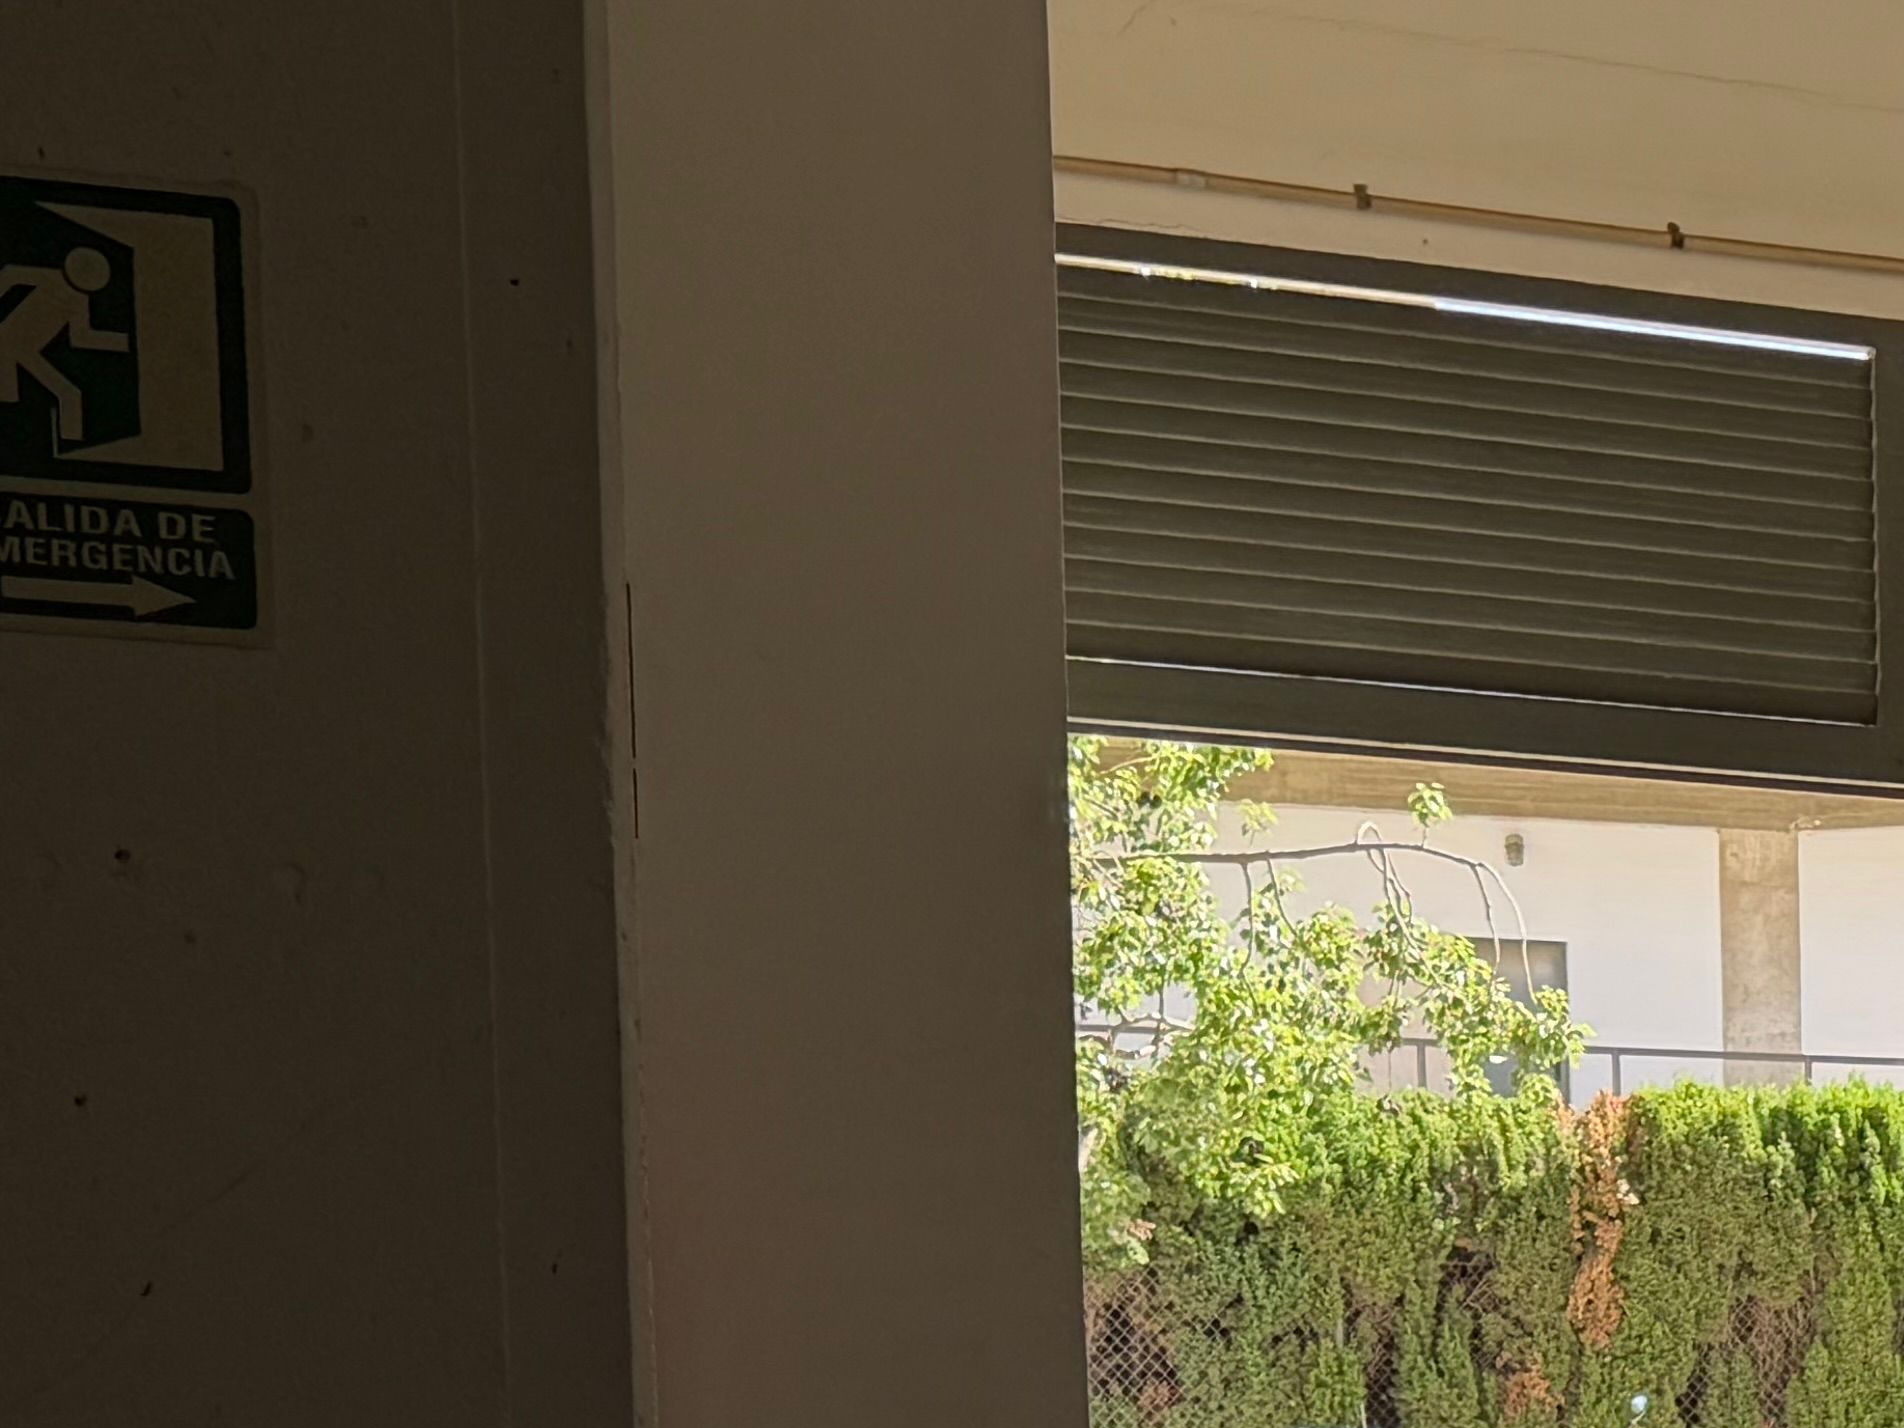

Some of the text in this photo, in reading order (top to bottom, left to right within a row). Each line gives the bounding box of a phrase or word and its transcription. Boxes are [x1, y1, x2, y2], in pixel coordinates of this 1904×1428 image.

[0, 499, 217, 543] ALIDA DE
[0, 535, 237, 580] MERGENCIA
